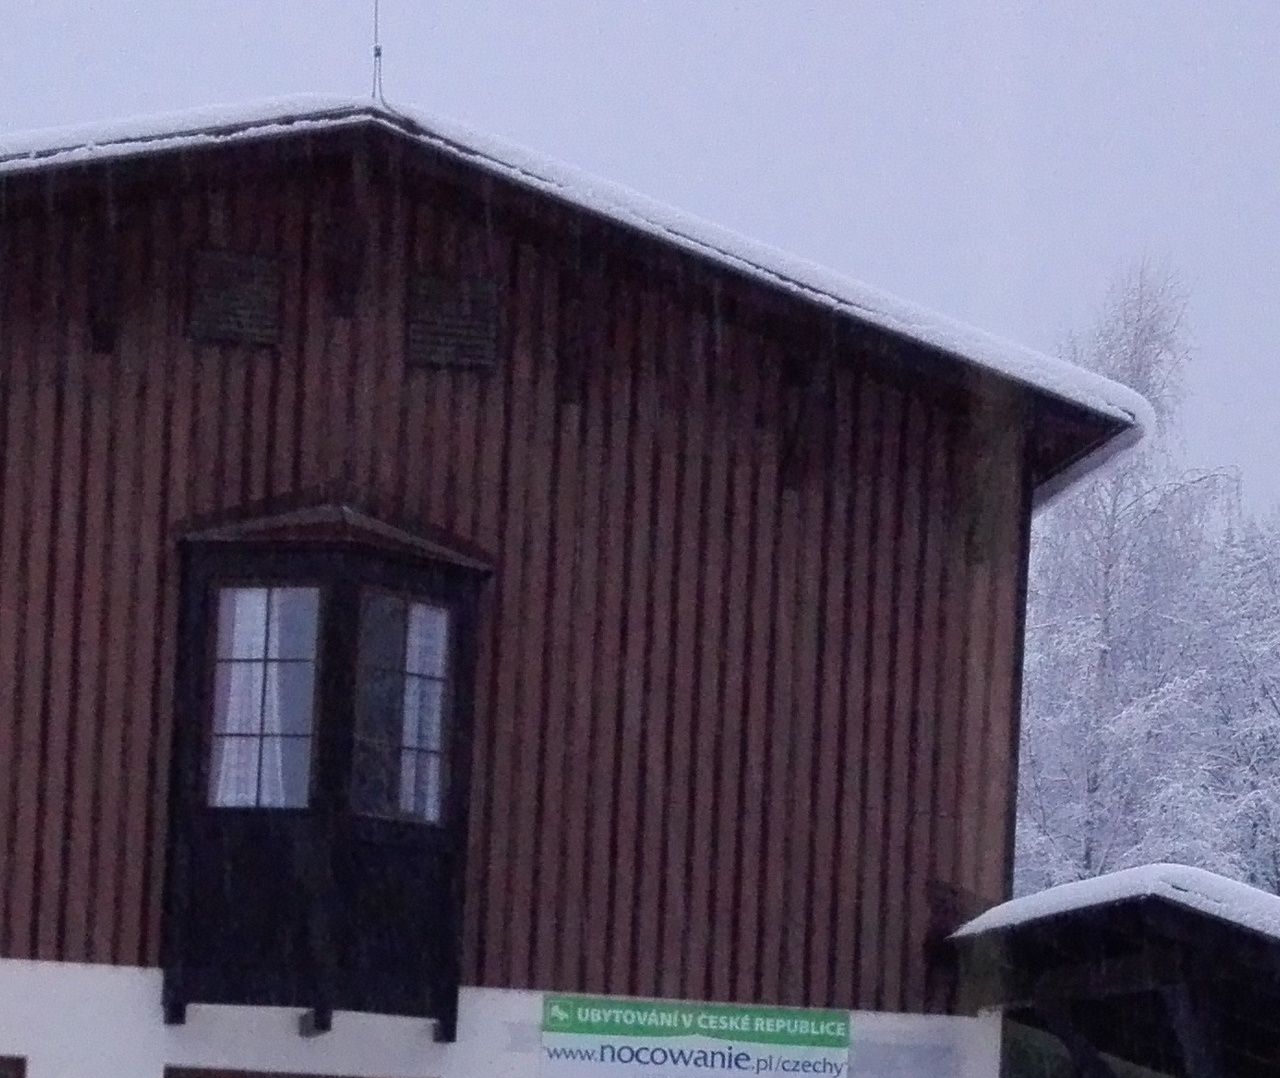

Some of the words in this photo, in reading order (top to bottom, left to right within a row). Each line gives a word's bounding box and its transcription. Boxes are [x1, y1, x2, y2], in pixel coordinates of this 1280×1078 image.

[577, 1006, 679, 1028] UBYTOVÁNÍ
[681, 1013, 693, 1028] V
[697, 1011, 751, 1031] ČESKÉ
[754, 1017, 846, 1037] REPUBLICE
[546, 1044, 844, 1078] www.nocowanie.pl/czechy
